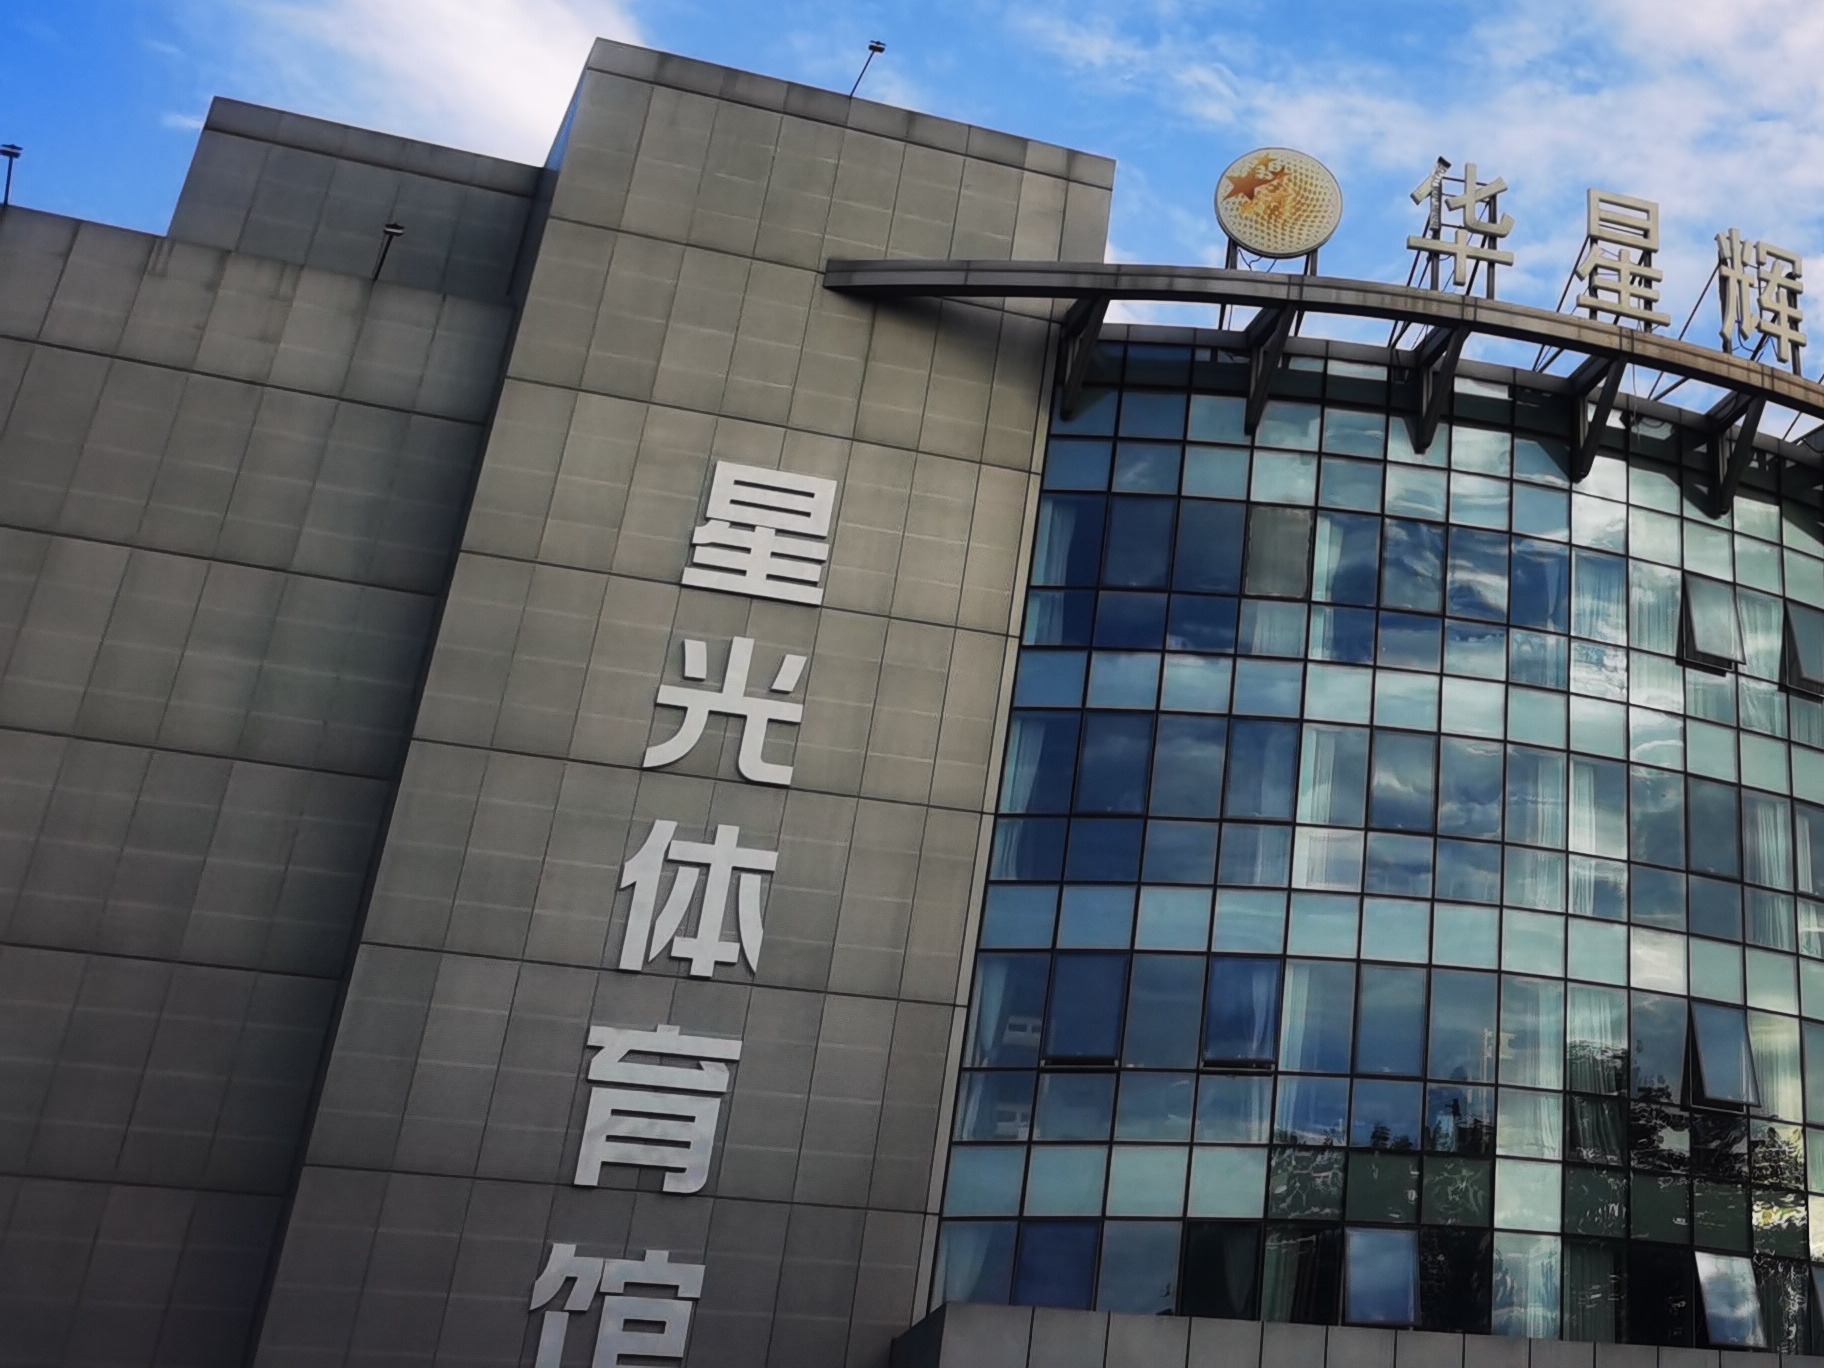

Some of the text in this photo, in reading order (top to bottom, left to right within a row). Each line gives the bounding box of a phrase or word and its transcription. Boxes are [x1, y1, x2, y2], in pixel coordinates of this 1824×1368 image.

[529, 460, 838, 1368] 星光体育馆
